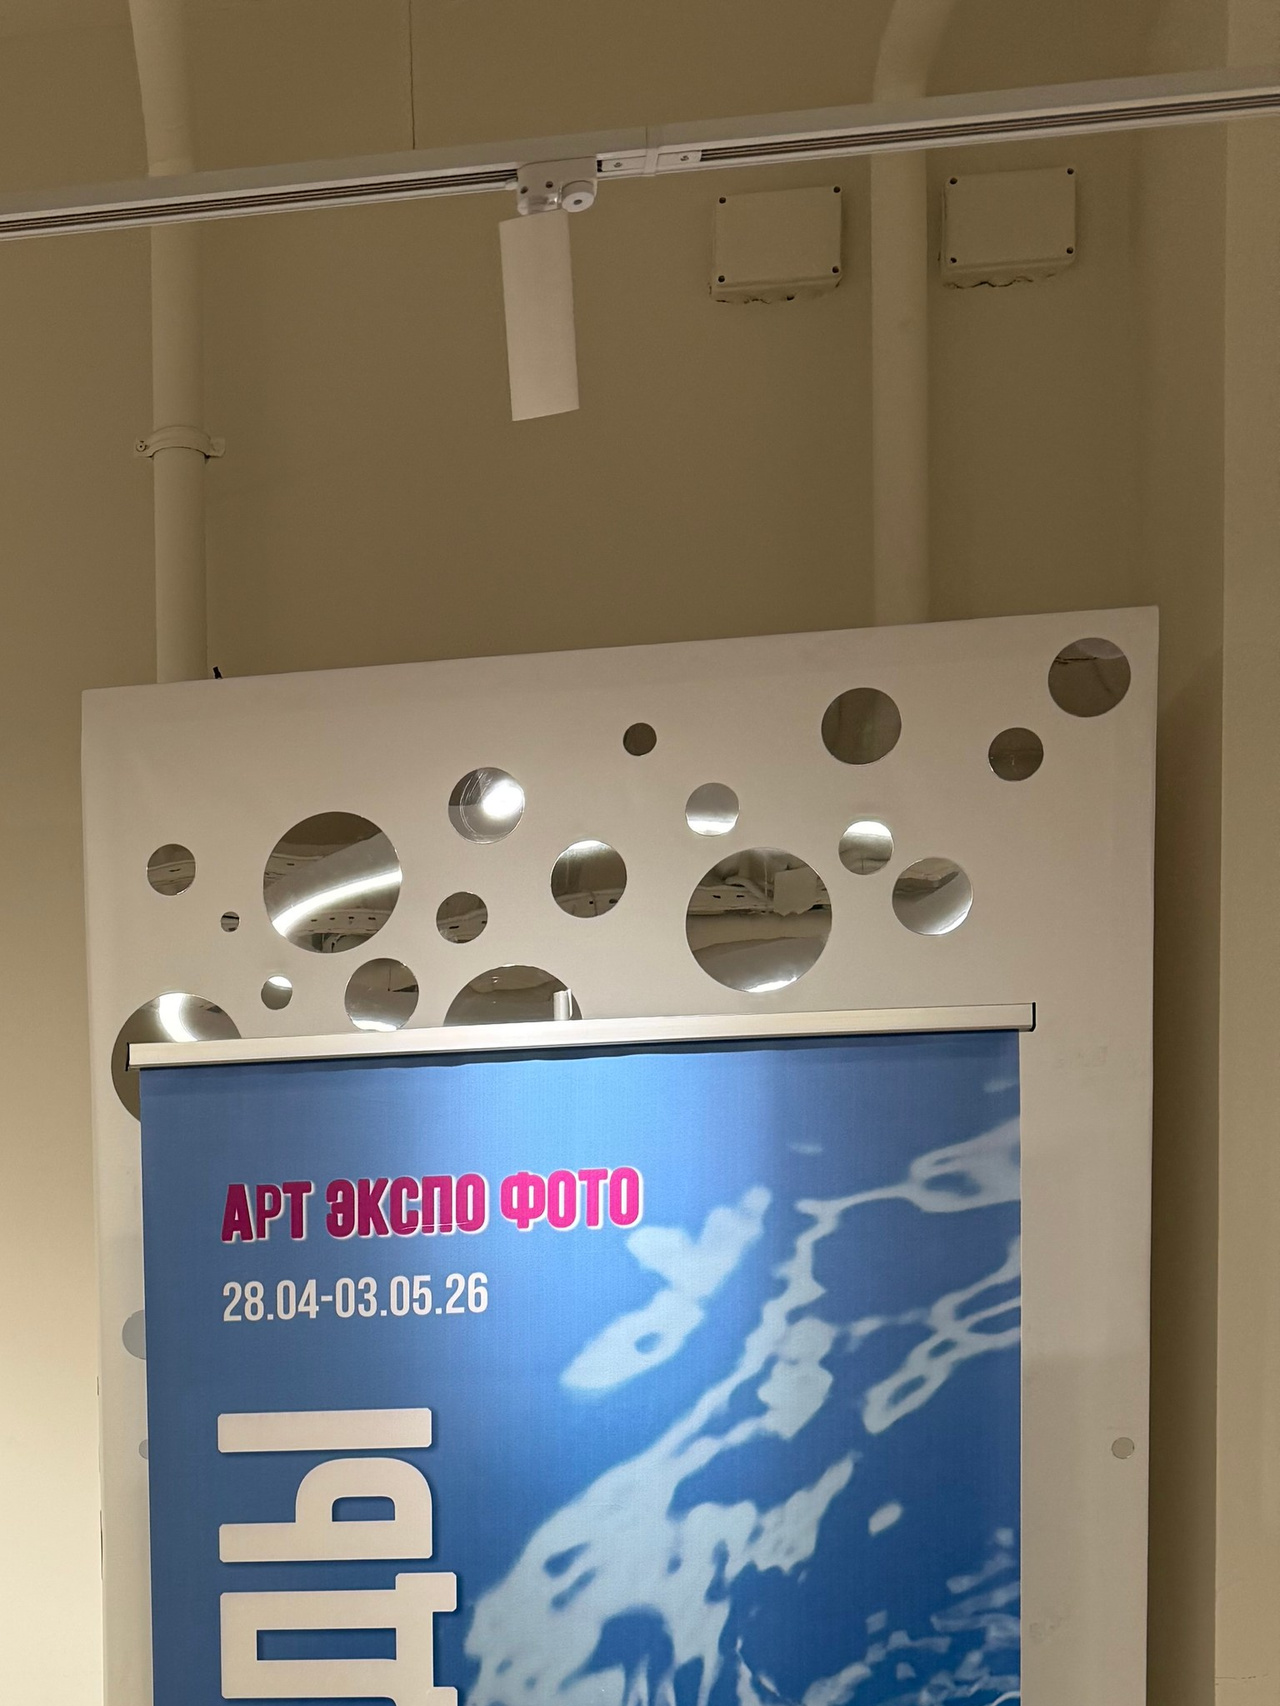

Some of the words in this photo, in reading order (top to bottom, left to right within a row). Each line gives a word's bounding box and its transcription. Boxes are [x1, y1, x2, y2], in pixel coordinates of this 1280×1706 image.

[219, 1179, 314, 1244] АРТ
[324, 1171, 488, 1241] ЭКСПО
[499, 1164, 643, 1233] ФОТО
[221, 1273, 489, 1324] 28.04-03.05.26
